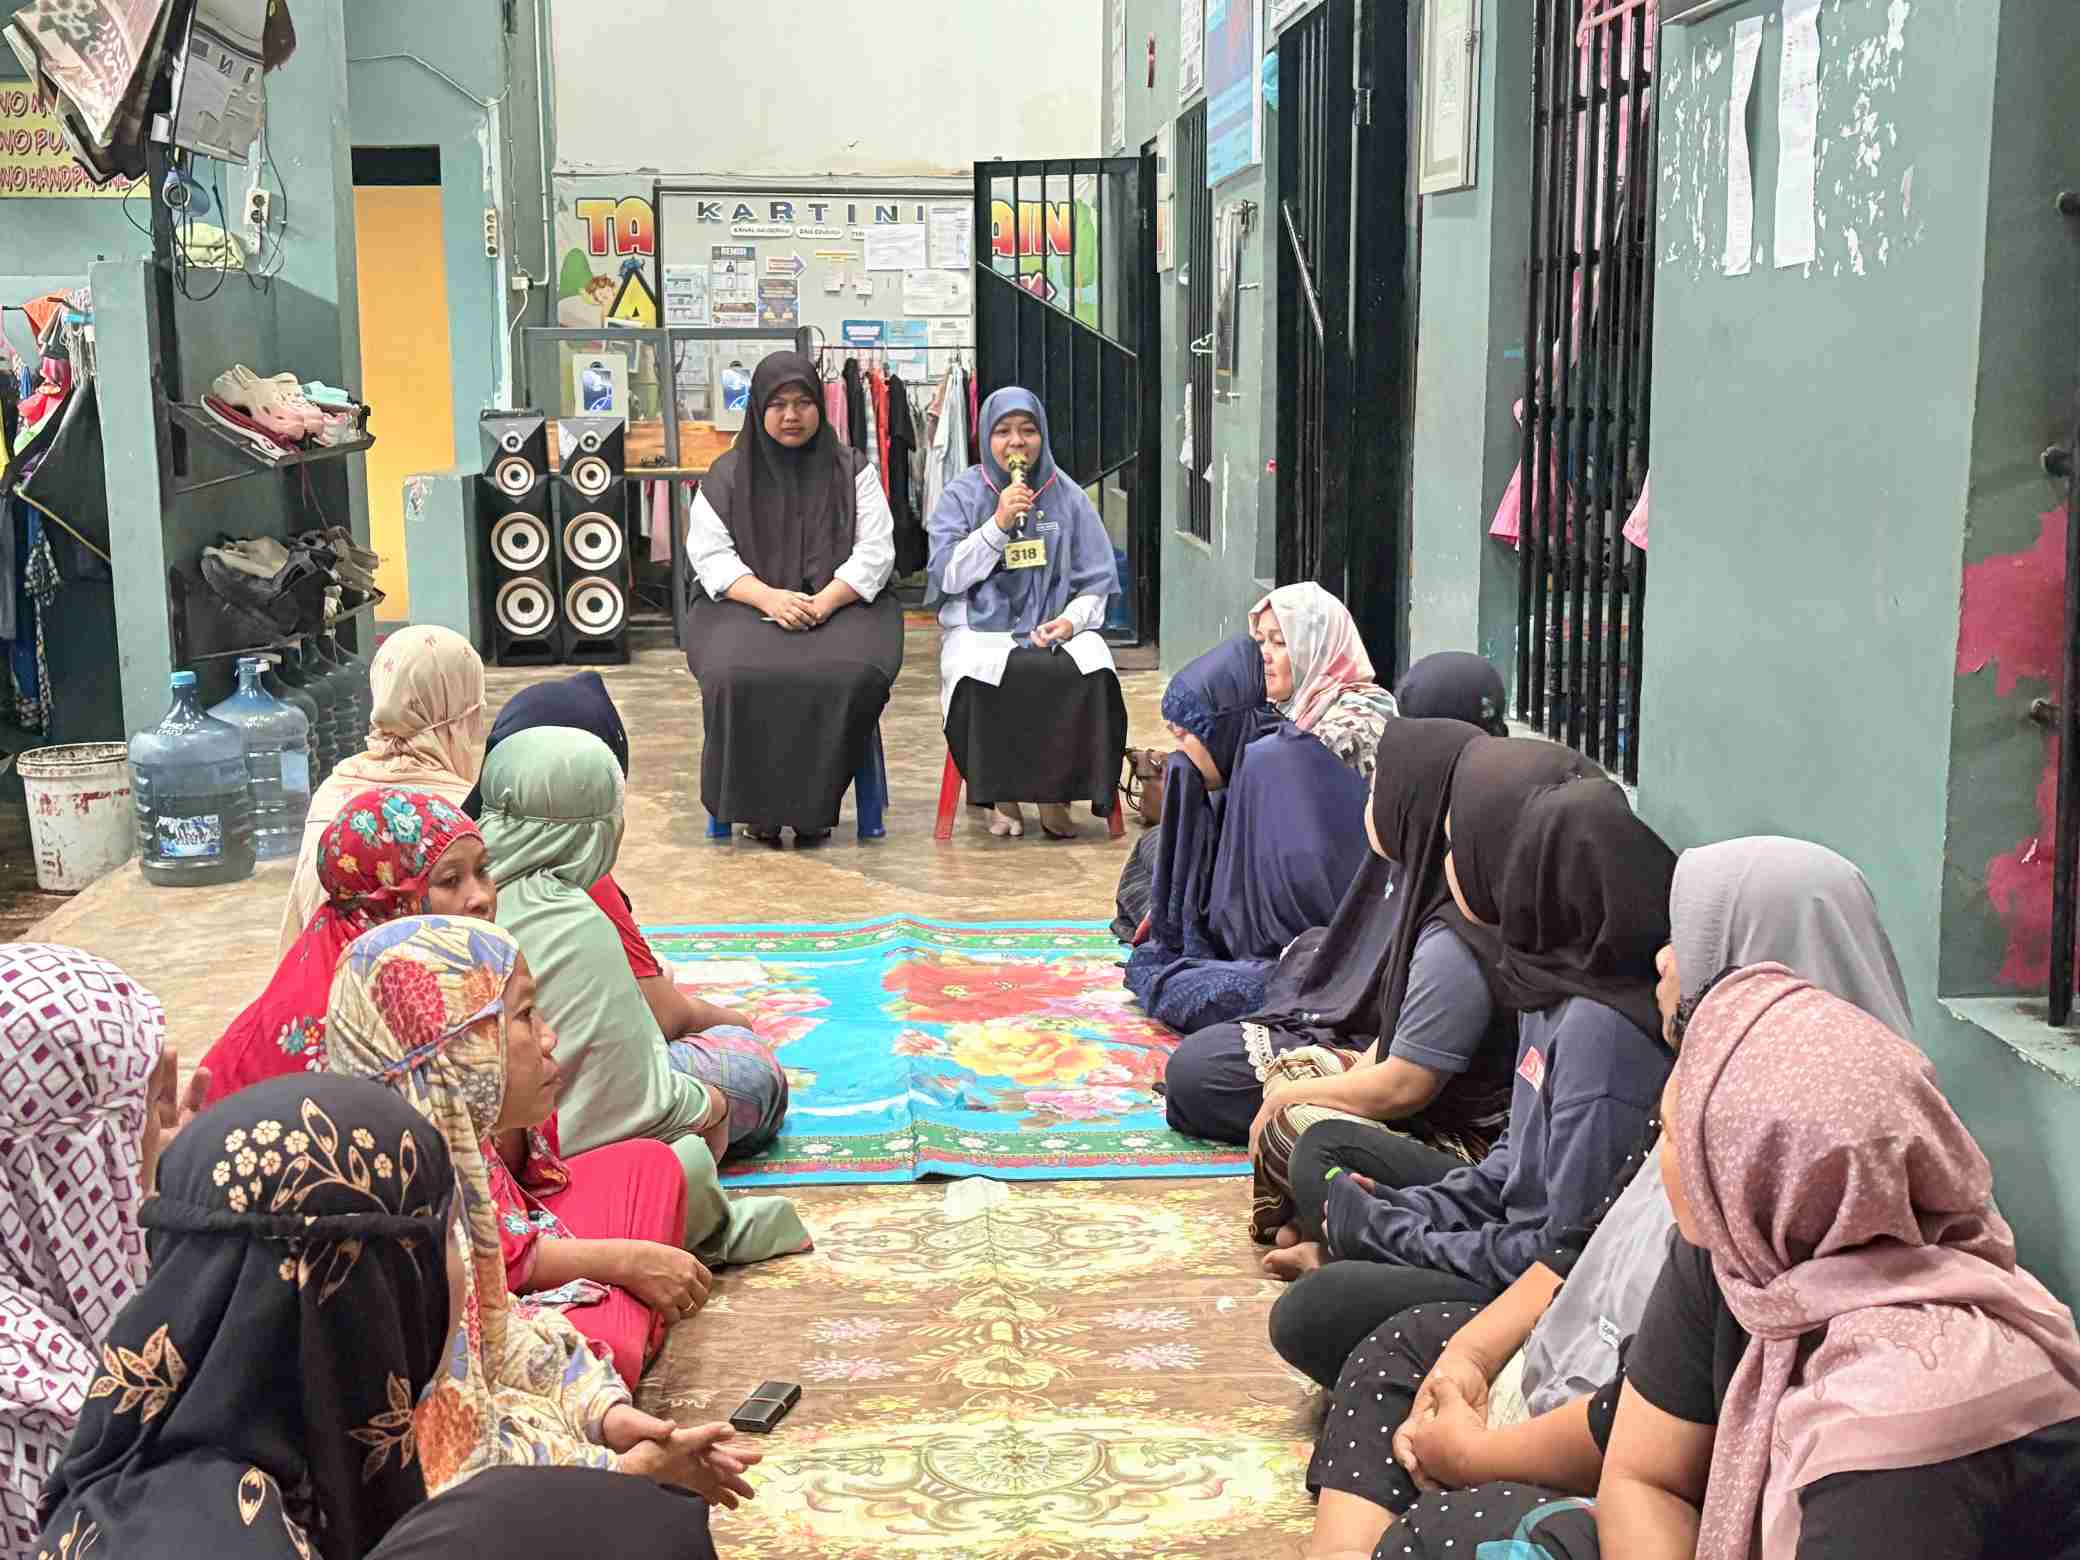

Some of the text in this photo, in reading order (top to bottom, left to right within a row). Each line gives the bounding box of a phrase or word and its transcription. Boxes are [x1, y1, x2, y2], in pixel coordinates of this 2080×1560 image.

[0, 90, 28, 117] NO
[0, 128, 32, 155] NO
[0, 165, 27, 192] NO
[697, 200, 926, 225] KARTINI
[1010, 547, 1038, 562] 318
